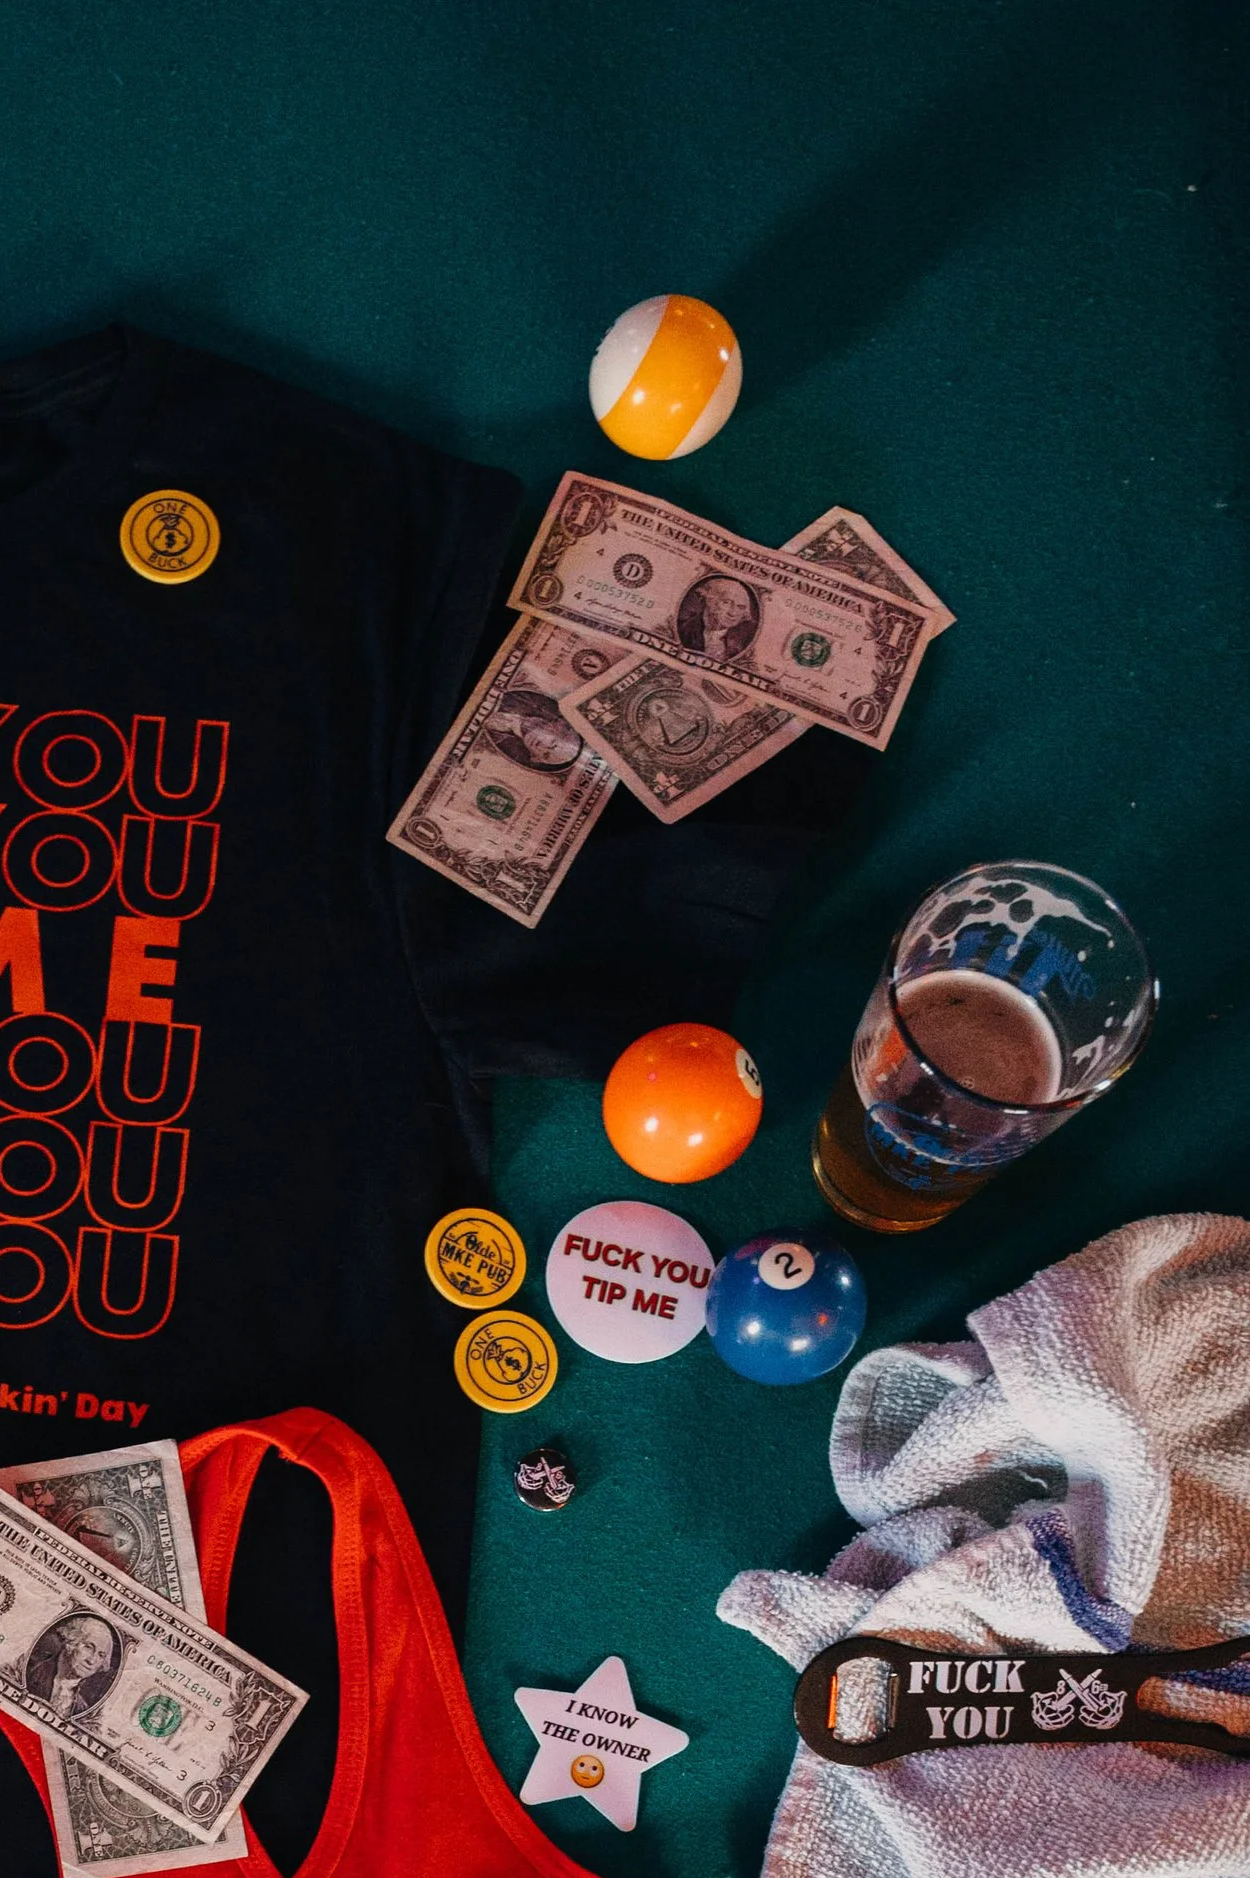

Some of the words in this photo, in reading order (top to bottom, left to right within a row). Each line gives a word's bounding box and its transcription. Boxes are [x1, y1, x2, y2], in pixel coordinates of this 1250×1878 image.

[153, 502, 188, 514] ONE
[149, 552, 187, 569] BUCK
[621, 508, 653, 528] THE
[656, 517, 712, 554] UNITED
[712, 547, 770, 583] STATES
[791, 578, 863, 614] AMERICA
[441, 1242, 477, 1269] MKE
[477, 1261, 506, 1284] PUB
[563, 1233, 648, 1276] FUCK
[650, 1253, 715, 1291] YOU
[772, 1251, 803, 1280] 2
[581, 1274, 628, 1307] TIP
[631, 1288, 680, 1321] ME
[469, 1328, 495, 1361] ONE
[517, 1361, 547, 1395] BUCK
[75, 1393, 149, 1428] Day
[29, 1544, 87, 1591] UNITED
[86, 1582, 143, 1628] STATES
[142, 1616, 165, 1641] OF
[161, 1632, 232, 1685] AMERICA
[907, 1660, 1027, 1694] FUCK
[1056, 1679, 1066, 1695] 8
[22, 1696, 108, 1759] DOLLAR
[565, 1699, 577, 1714] I
[577, 1702, 640, 1730] KNOW
[926, 1706, 1015, 1740] YOU
[541, 1720, 580, 1743] THE
[582, 1732, 652, 1763] OWNER
